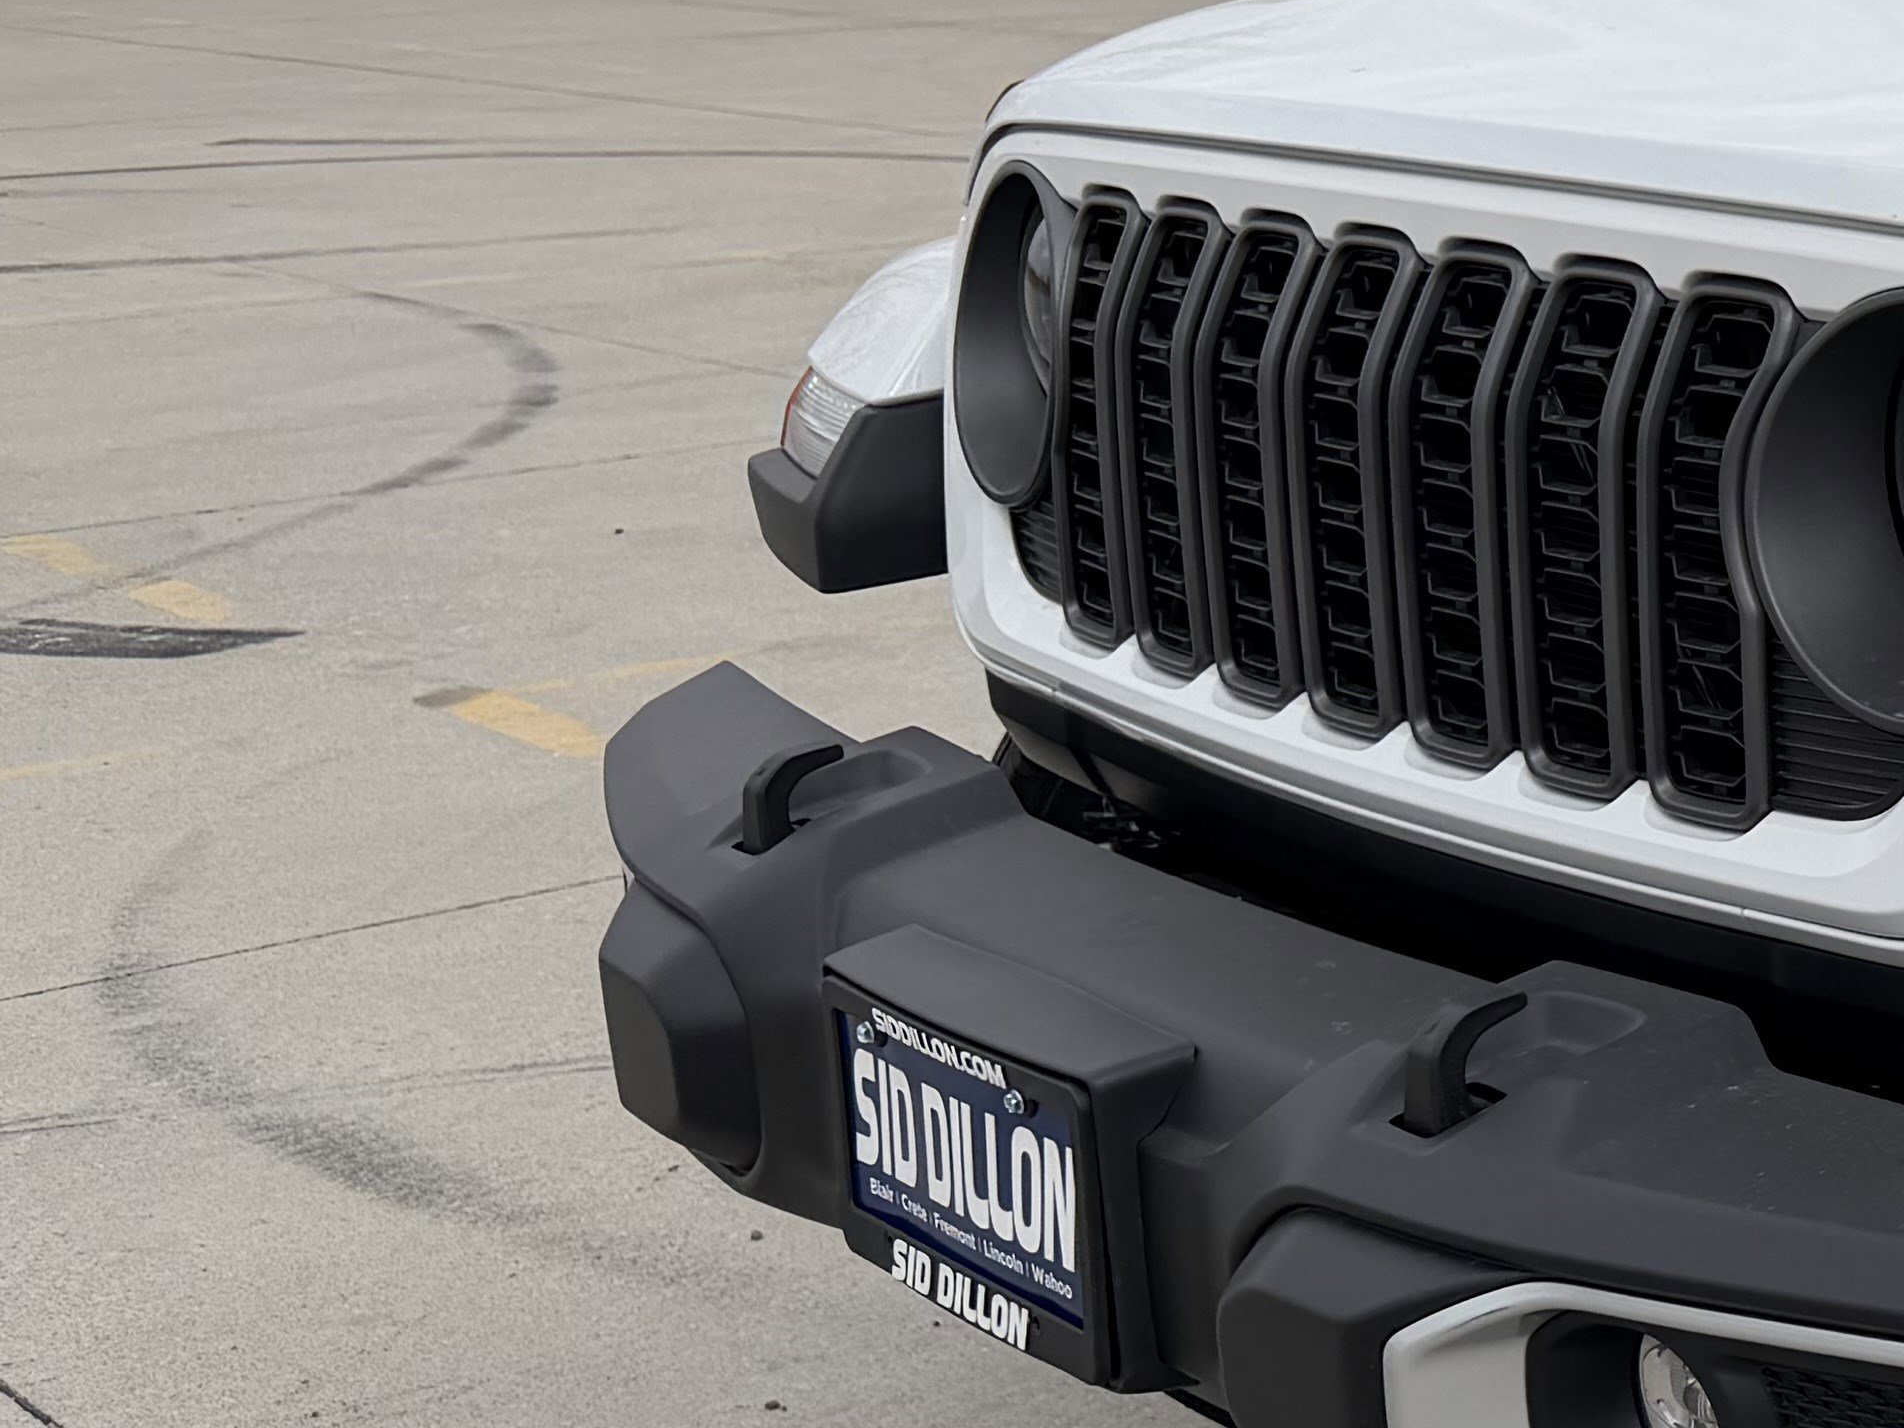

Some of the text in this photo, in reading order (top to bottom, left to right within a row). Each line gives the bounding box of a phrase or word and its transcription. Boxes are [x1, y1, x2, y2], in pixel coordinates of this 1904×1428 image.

[871, 1007, 1007, 1089] SIDDILLON.COM
[853, 1048, 1076, 1273] SID DILLON
[869, 1177, 1073, 1299] Blair Crete Fremont Lincoln Wahoo
[891, 1238, 1030, 1351] SID DILLON
